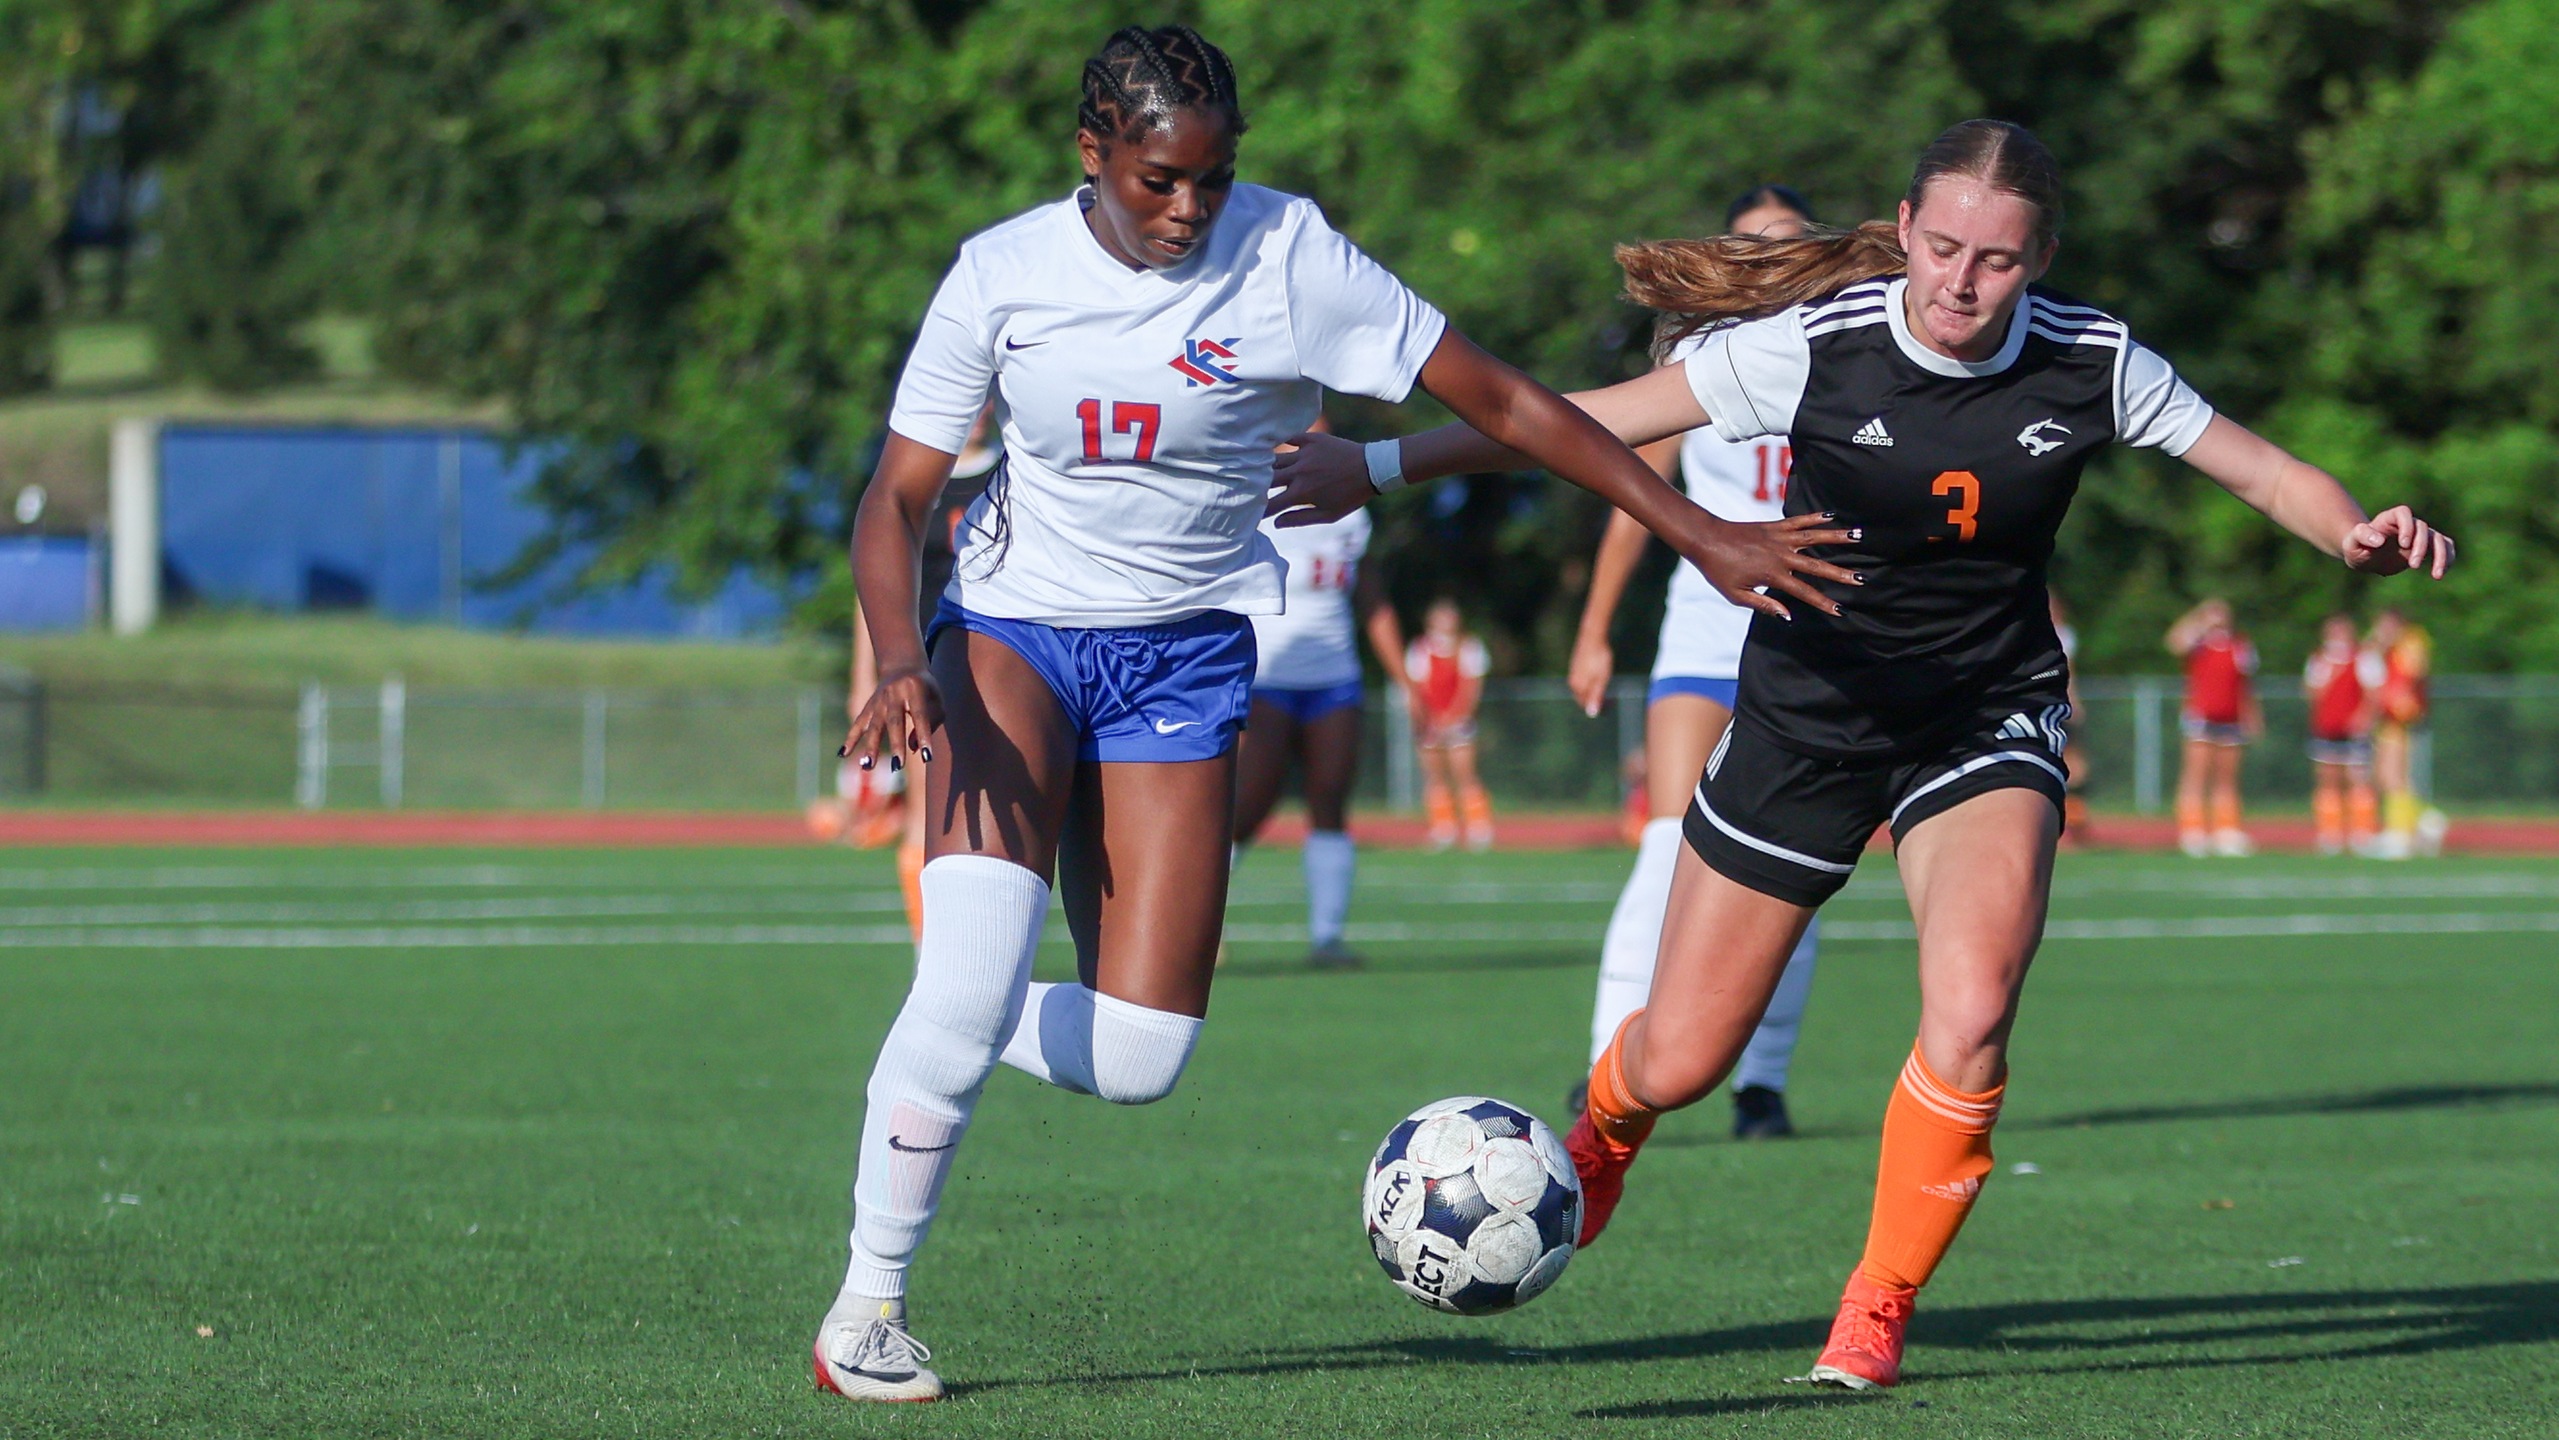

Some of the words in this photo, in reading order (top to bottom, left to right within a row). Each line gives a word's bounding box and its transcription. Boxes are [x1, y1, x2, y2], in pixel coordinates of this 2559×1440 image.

[1076, 397, 1161, 465] 17
[1852, 434, 1894, 447] adidas
[1927, 471, 1980, 542] 3
[1379, 1171, 1411, 1225] KCK
[1411, 1244, 1449, 1308] LECT
